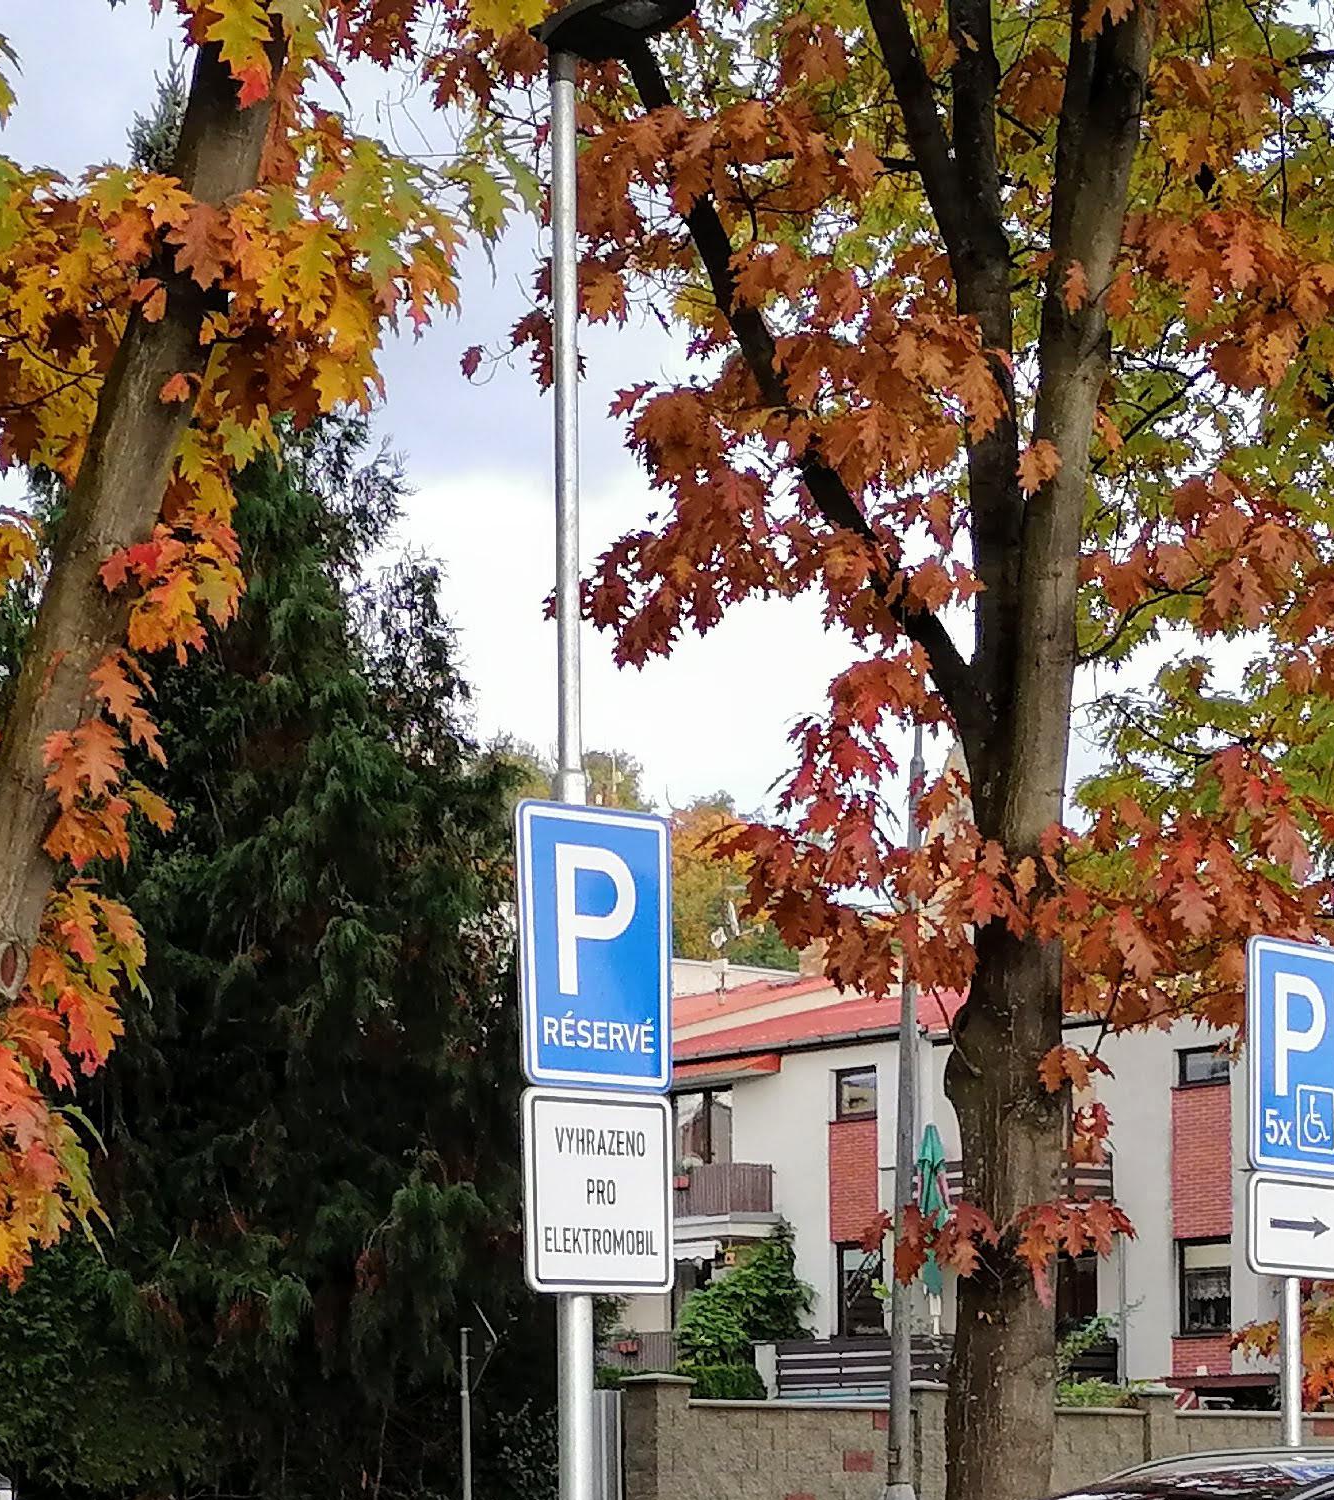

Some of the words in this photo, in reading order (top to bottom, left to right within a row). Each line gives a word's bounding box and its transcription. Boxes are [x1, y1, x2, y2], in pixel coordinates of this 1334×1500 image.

[554, 842, 637, 997] P
[542, 1010, 656, 1055] RÉSERVÉ
[1274, 971, 1327, 1097] P
[554, 1126, 646, 1159] VYHRAZENO
[1264, 1107, 1293, 1147] 5x
[586, 1177, 617, 1206] PRO
[543, 1225, 659, 1258] ELEKTROMOBIL
